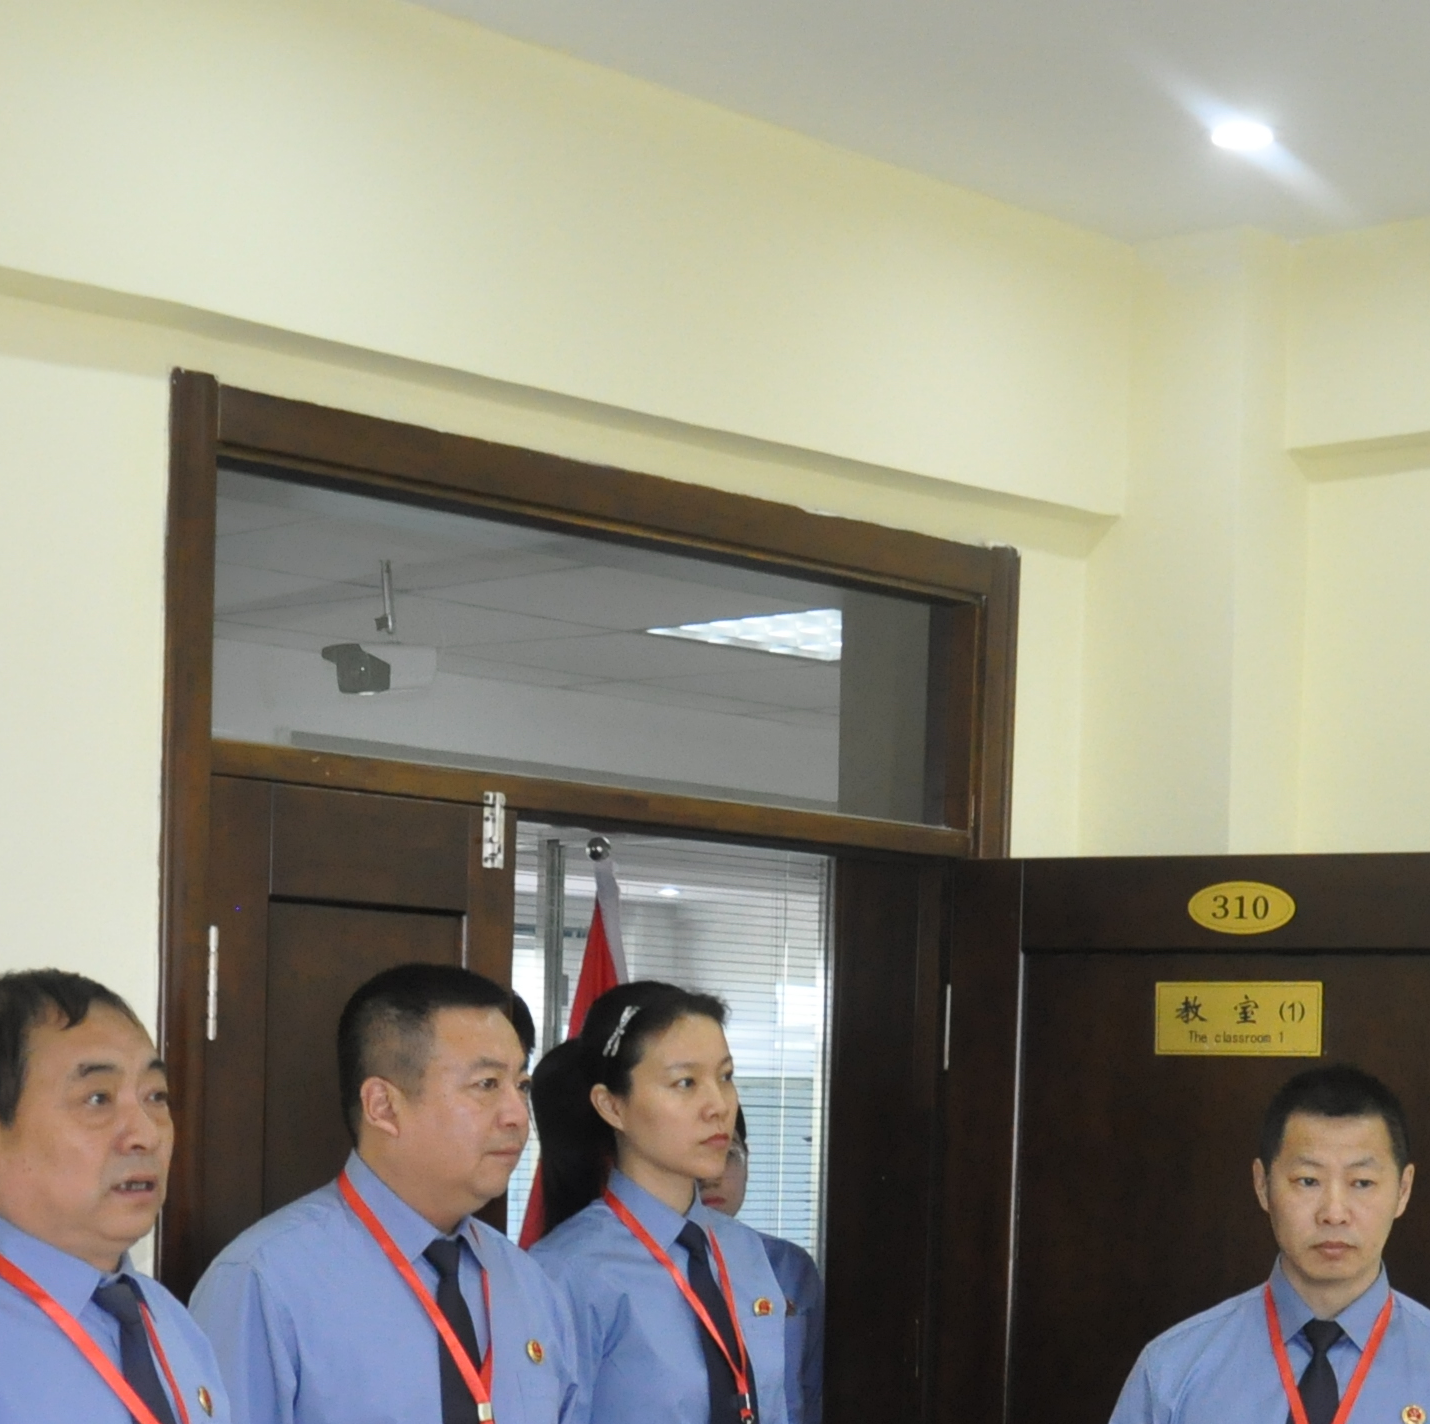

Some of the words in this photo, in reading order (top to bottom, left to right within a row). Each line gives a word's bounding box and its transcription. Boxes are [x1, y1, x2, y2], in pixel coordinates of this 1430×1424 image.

[1211, 895, 1270, 920] 310
[1188, 1029, 1208, 1043] The
[1214, 1031, 1272, 1044] classroom
[1279, 1031, 1284, 1043] 1
